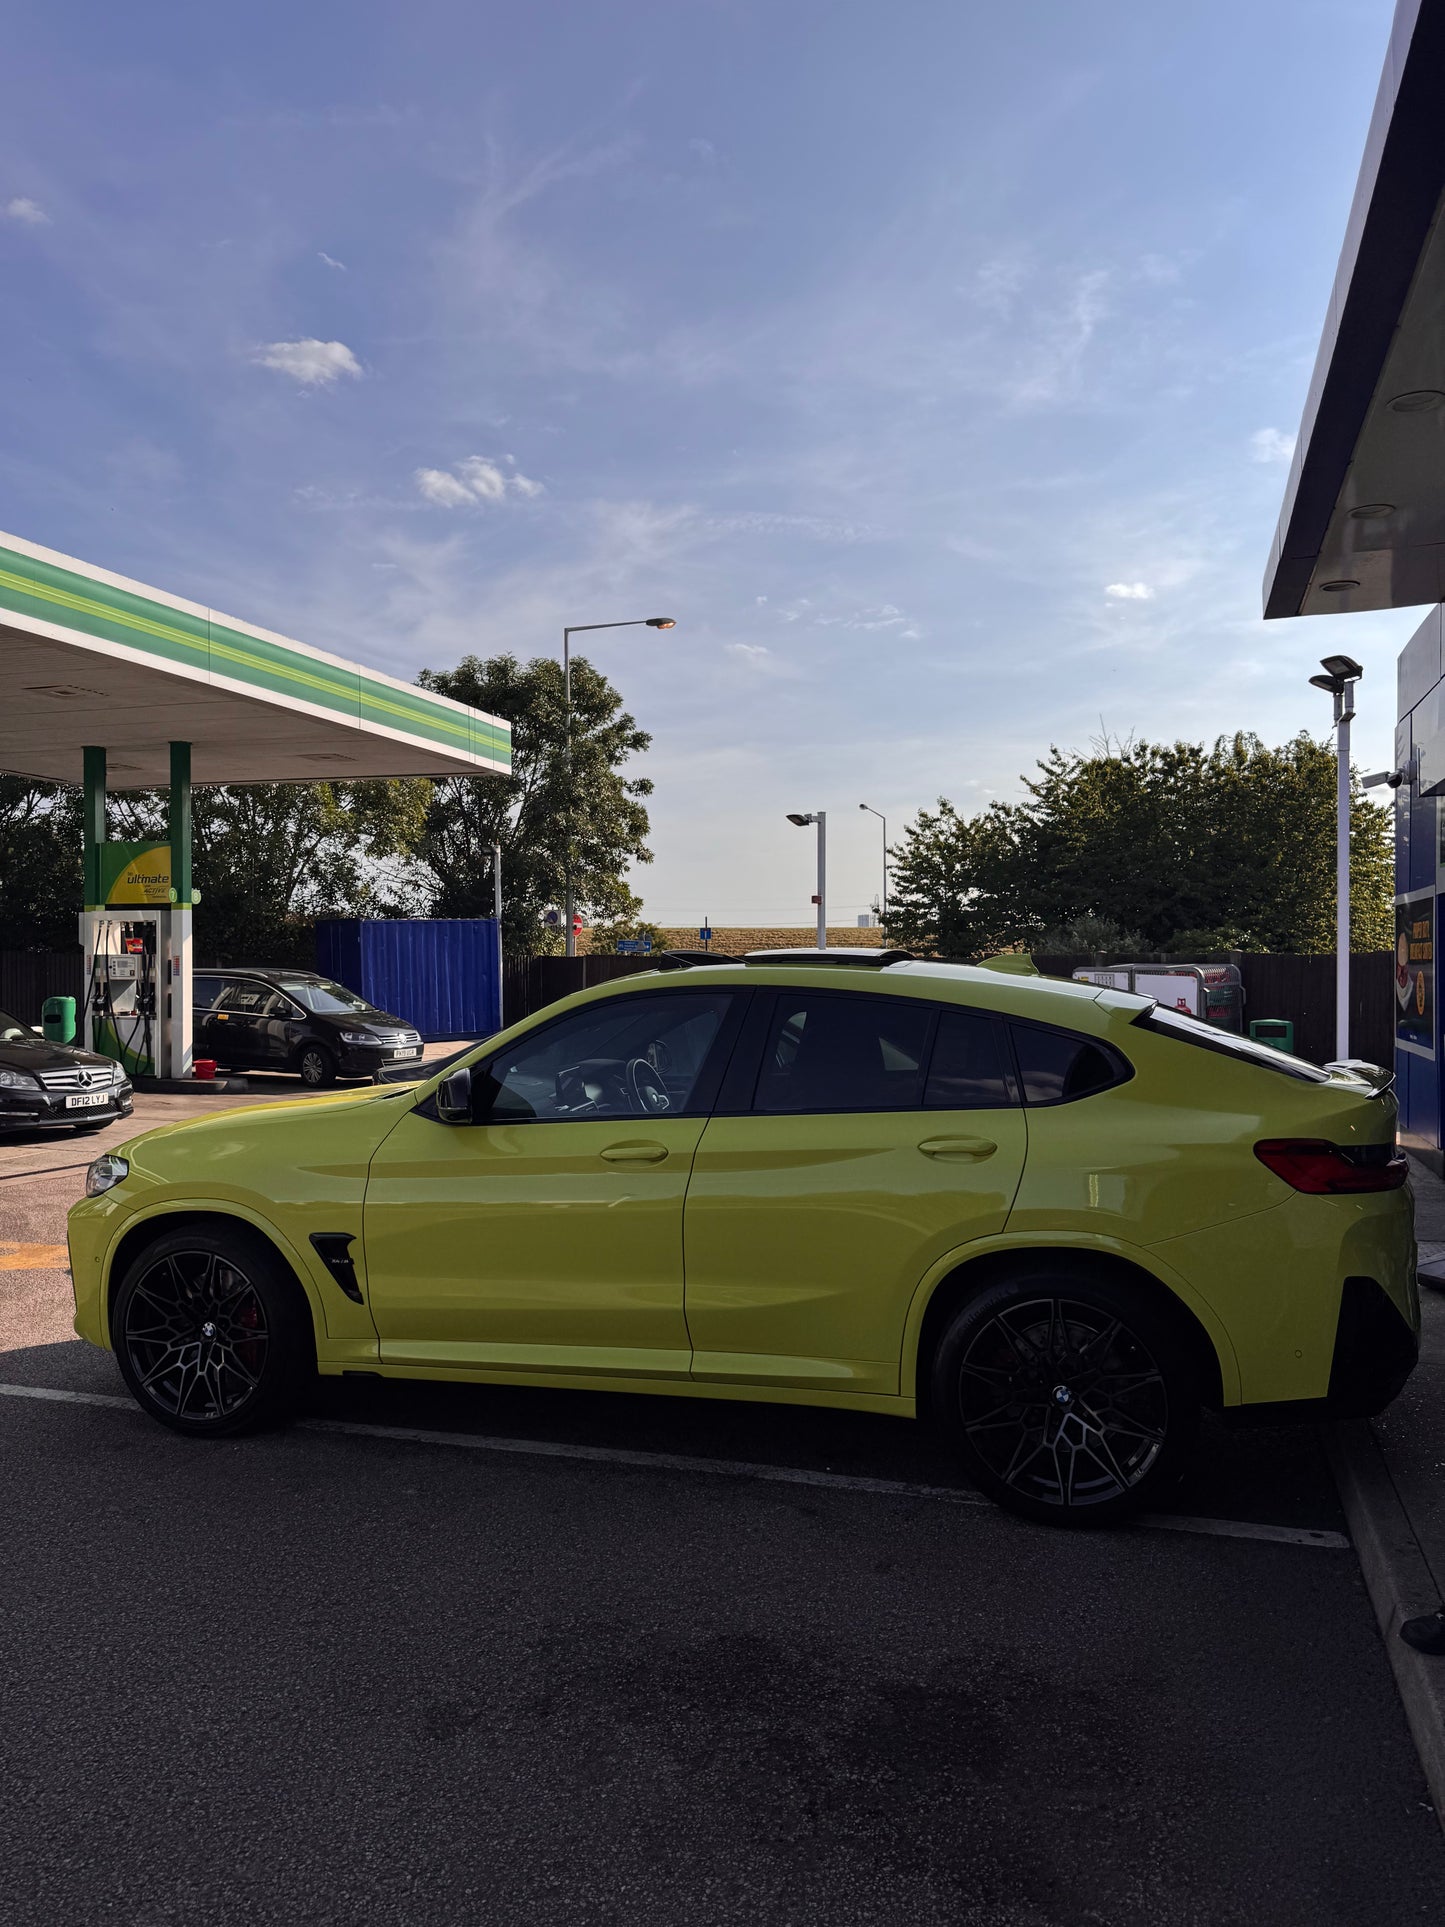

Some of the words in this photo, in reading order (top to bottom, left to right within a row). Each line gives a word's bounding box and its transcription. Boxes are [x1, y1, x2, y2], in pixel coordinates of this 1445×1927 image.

[127, 873, 169, 884] ultimate
[71, 1096, 90, 1106] DF12
[91, 1094, 105, 1104] LYJ
